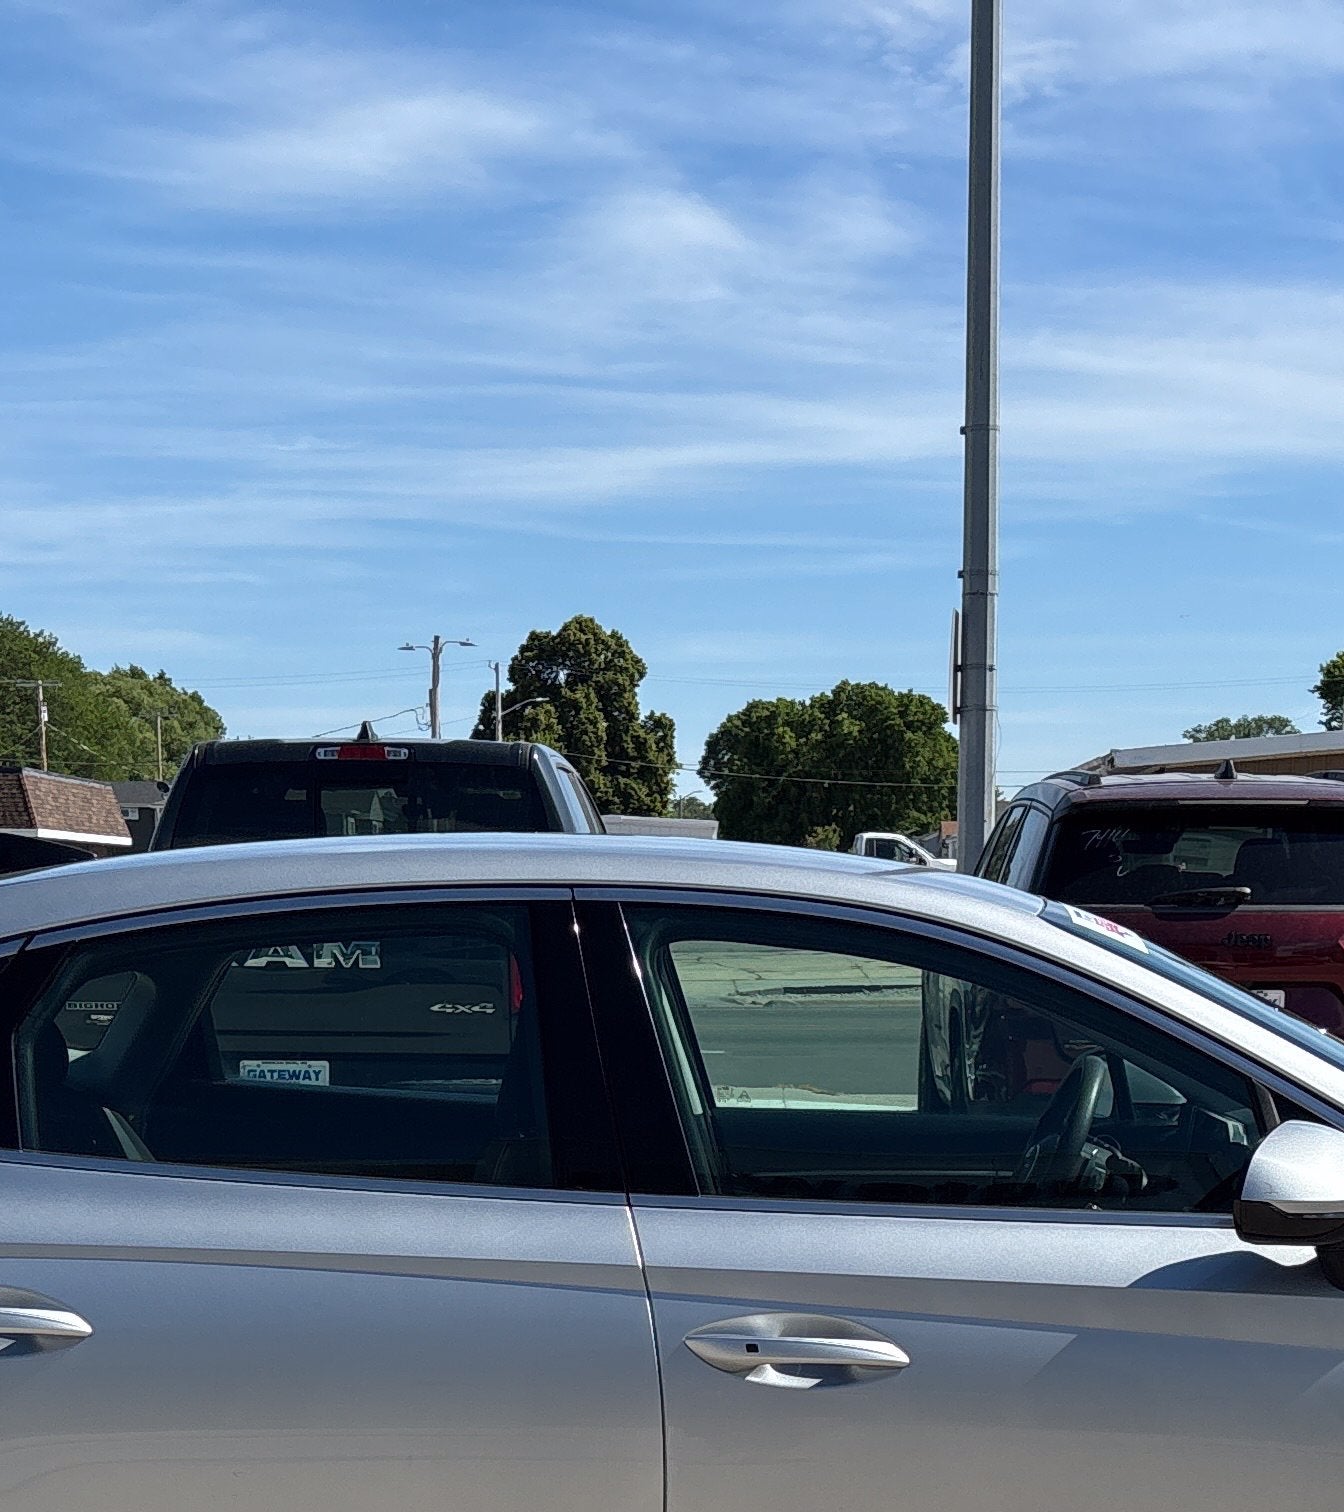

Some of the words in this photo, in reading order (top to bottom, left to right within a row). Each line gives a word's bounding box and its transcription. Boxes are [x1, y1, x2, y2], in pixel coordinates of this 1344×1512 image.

[231, 941, 381, 968] AM
[430, 1002, 496, 1014] 4x4
[247, 1069, 322, 1081] GATEWAY
